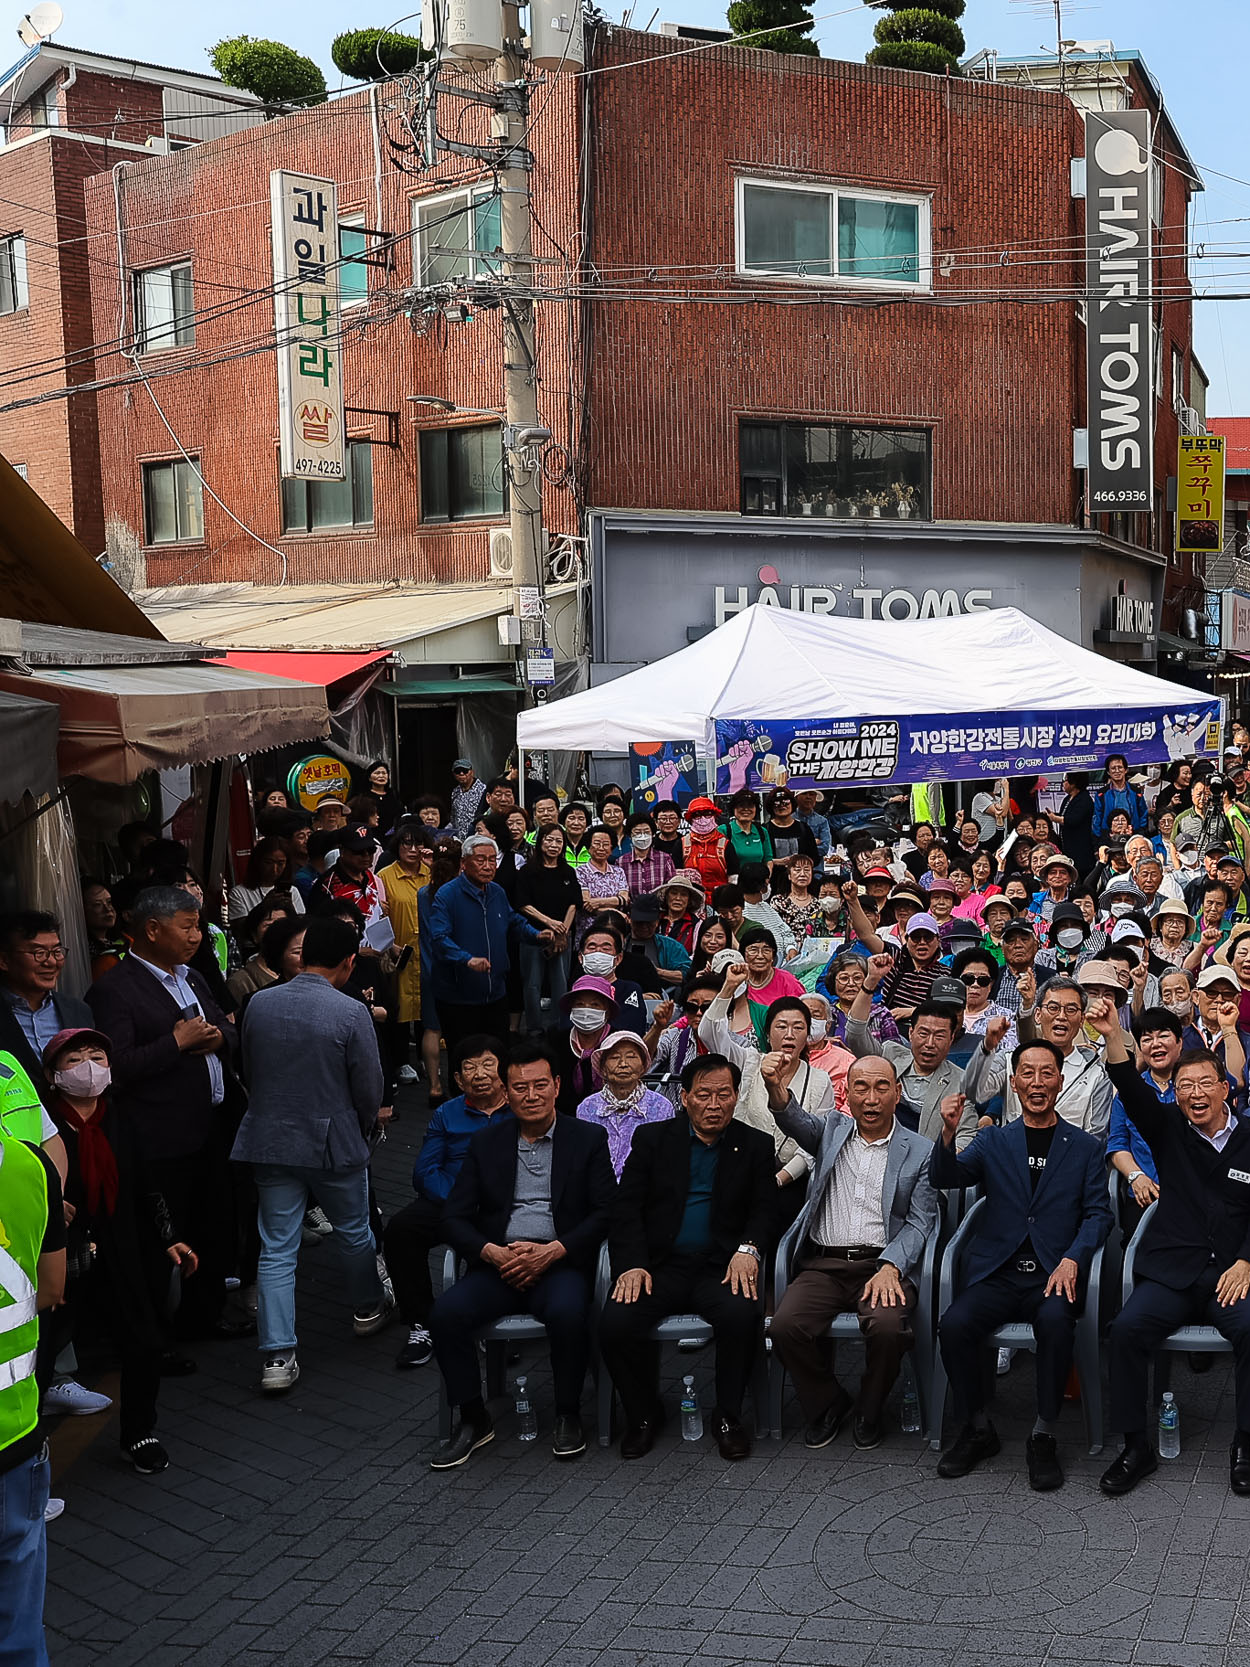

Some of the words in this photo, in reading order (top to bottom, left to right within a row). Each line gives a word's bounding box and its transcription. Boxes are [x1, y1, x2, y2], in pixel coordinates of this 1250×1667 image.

[1099, 186, 1140, 313] HAIR
[292, 187, 333, 388] 과일나라
[1099, 323, 1141, 471] TOMS
[300, 405, 332, 443] 쌀
[1180, 438, 1223, 453] 부뚜막
[295, 459, 342, 475] 497-4225
[1094, 490, 1147, 502] 466.9336
[715, 586, 837, 627] HAIR
[853, 588, 992, 621] TOMS
[1116, 595, 1134, 633] HAIR
[1134, 600, 1154, 634] TOMS
[860, 723, 897, 738] 2024
[909, 724, 1055, 755] 자양한강전통시장
[1059, 724, 1091, 747] 상인
[789, 740, 859, 761] SHOW
[861, 738, 896, 758] ME
[790, 762, 820, 775] THE
